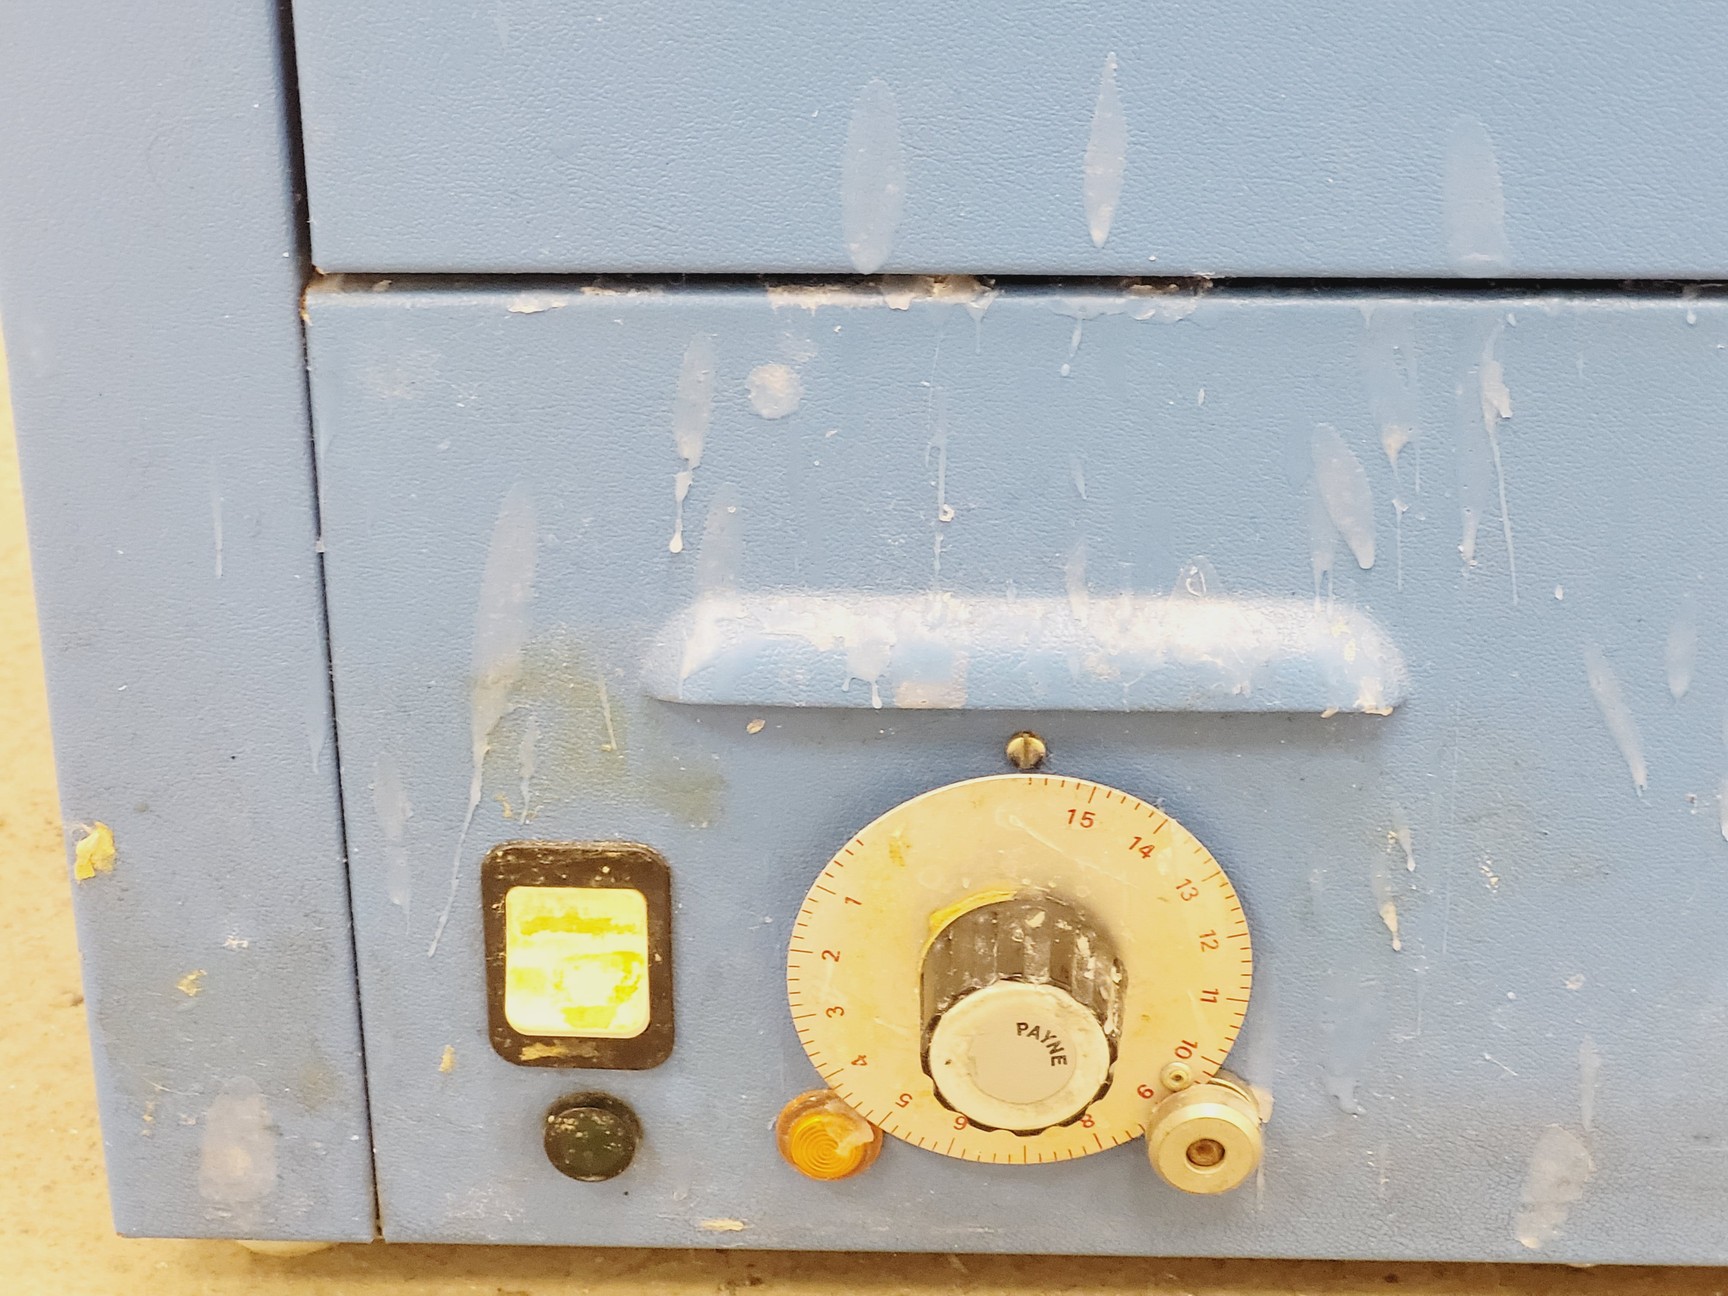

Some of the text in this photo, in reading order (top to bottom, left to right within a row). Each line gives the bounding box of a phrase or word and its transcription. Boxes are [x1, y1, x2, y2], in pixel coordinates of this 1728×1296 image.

[1067, 808, 1096, 829] 15
[1128, 836, 1156, 860] 14
[1176, 878, 1199, 902] 13
[844, 896, 863, 906] 1
[1199, 929, 1220, 952] 12
[821, 949, 841, 963] 2
[1200, 988, 1220, 1004] 11
[825, 1006, 845, 1019] 3
[1016, 1022, 1068, 1067] PAYNE
[1174, 1040, 1198, 1060] 10
[851, 1054, 868, 1067] 4
[1136, 1083, 1155, 1099] 9
[895, 1093, 913, 1108] 5
[953, 1115, 969, 1131] 6
[1080, 1113, 1096, 1129] 8
